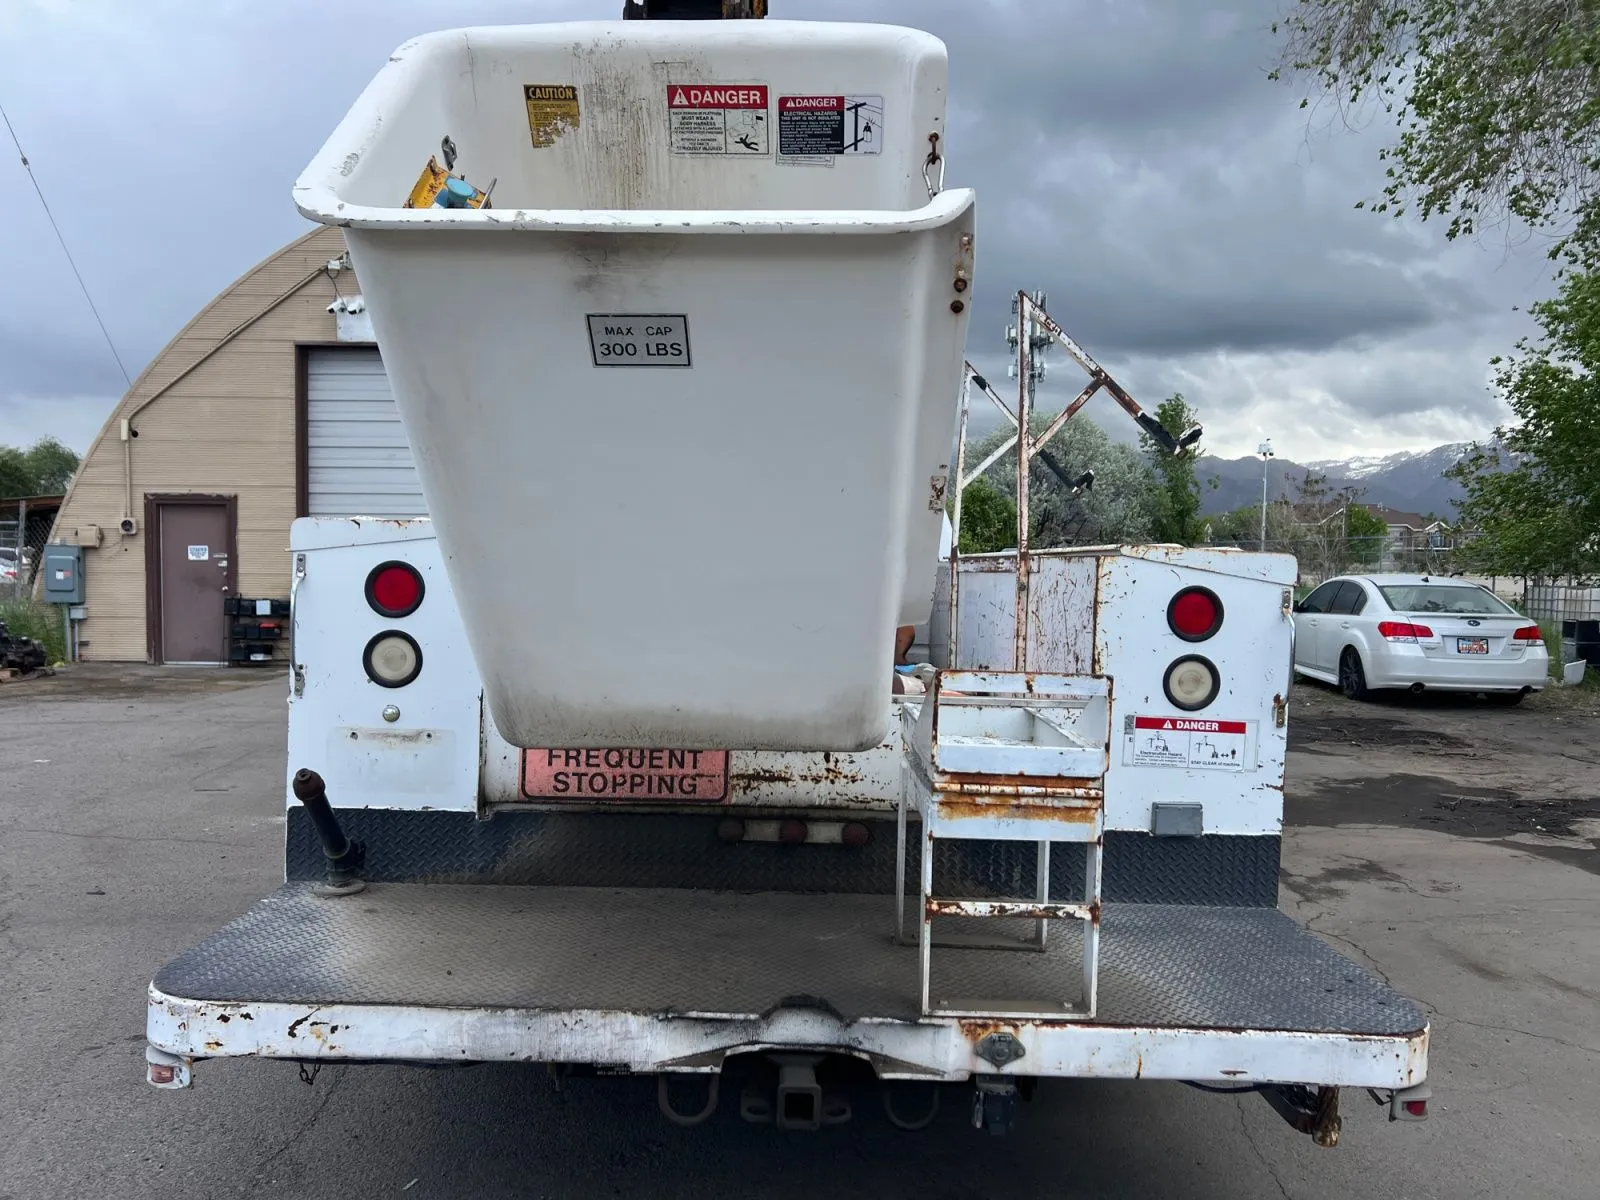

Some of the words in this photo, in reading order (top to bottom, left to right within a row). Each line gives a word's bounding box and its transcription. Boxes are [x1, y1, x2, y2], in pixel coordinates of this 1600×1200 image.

[529, 87, 573, 99] CAUTION
[690, 90, 761, 104] DANGER
[796, 98, 837, 107] DANGER
[604, 326, 634, 336] MAX
[645, 326, 673, 336] CAP
[600, 343, 637, 356] 300
[645, 343, 682, 356] LBS
[1176, 720, 1219, 731] DANGER
[547, 749, 703, 769] FREQUENT
[552, 771, 697, 795] STOPPING
